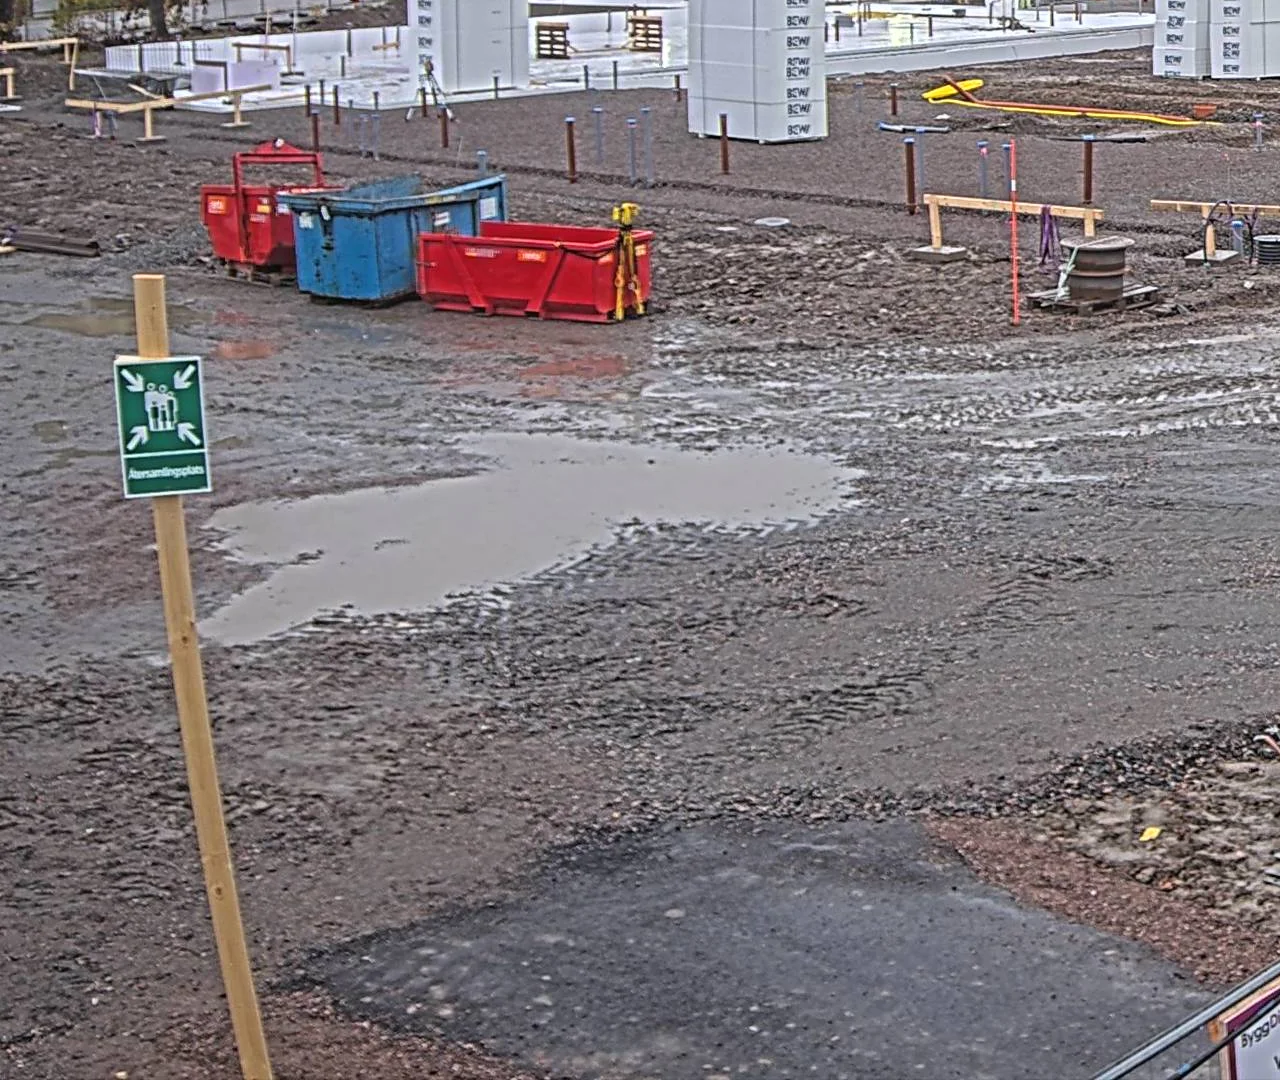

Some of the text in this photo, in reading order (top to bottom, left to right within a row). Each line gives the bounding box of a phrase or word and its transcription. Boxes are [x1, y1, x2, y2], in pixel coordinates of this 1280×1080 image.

[786, 16, 810, 26] BEWI
[787, 36, 811, 47] BEWI
[786, 67, 810, 77] BEWI
[787, 87, 810, 98] BEWI
[788, 103, 811, 114] BEWI
[788, 124, 811, 135] BEWI
